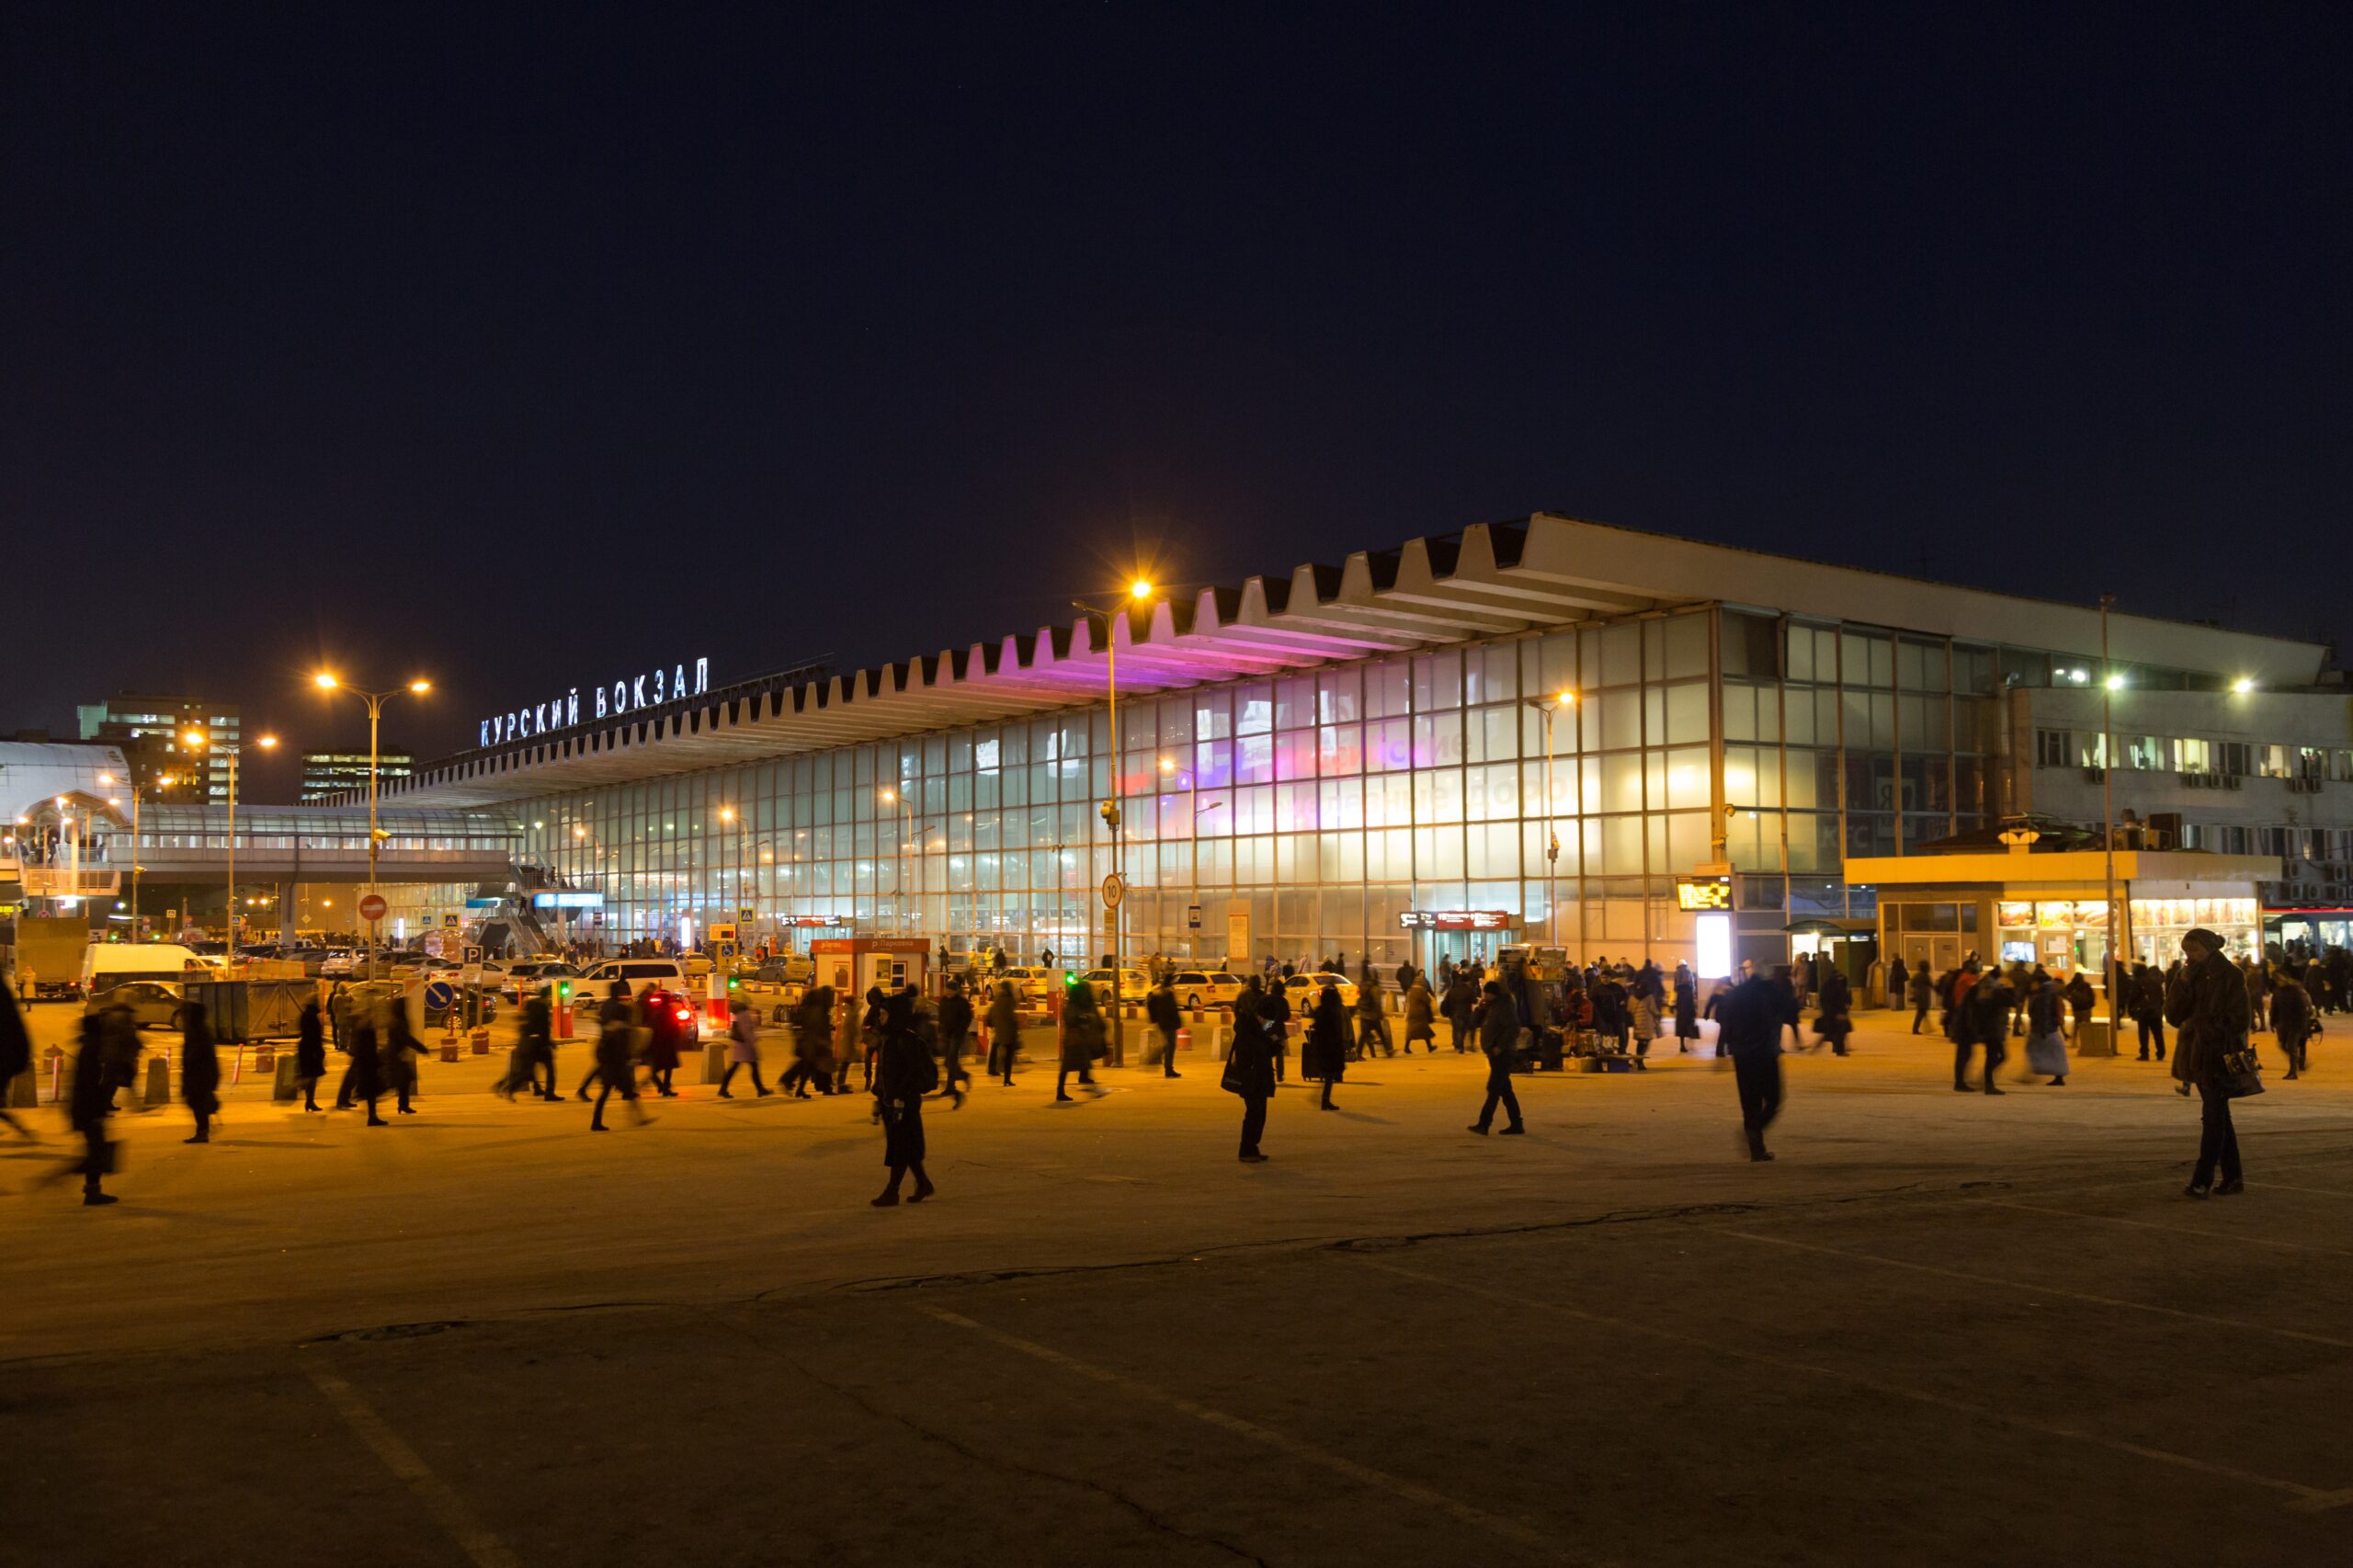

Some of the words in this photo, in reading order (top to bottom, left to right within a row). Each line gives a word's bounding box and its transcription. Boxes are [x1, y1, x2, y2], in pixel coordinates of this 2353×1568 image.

[481, 687, 578, 746] КУРСКИЙ
[597, 657, 708, 718] ВОКЗАЛ
[1108, 885, 1116, 897] 10
[881, 939, 914, 948] Парковка
[469, 949, 478, 962] P
